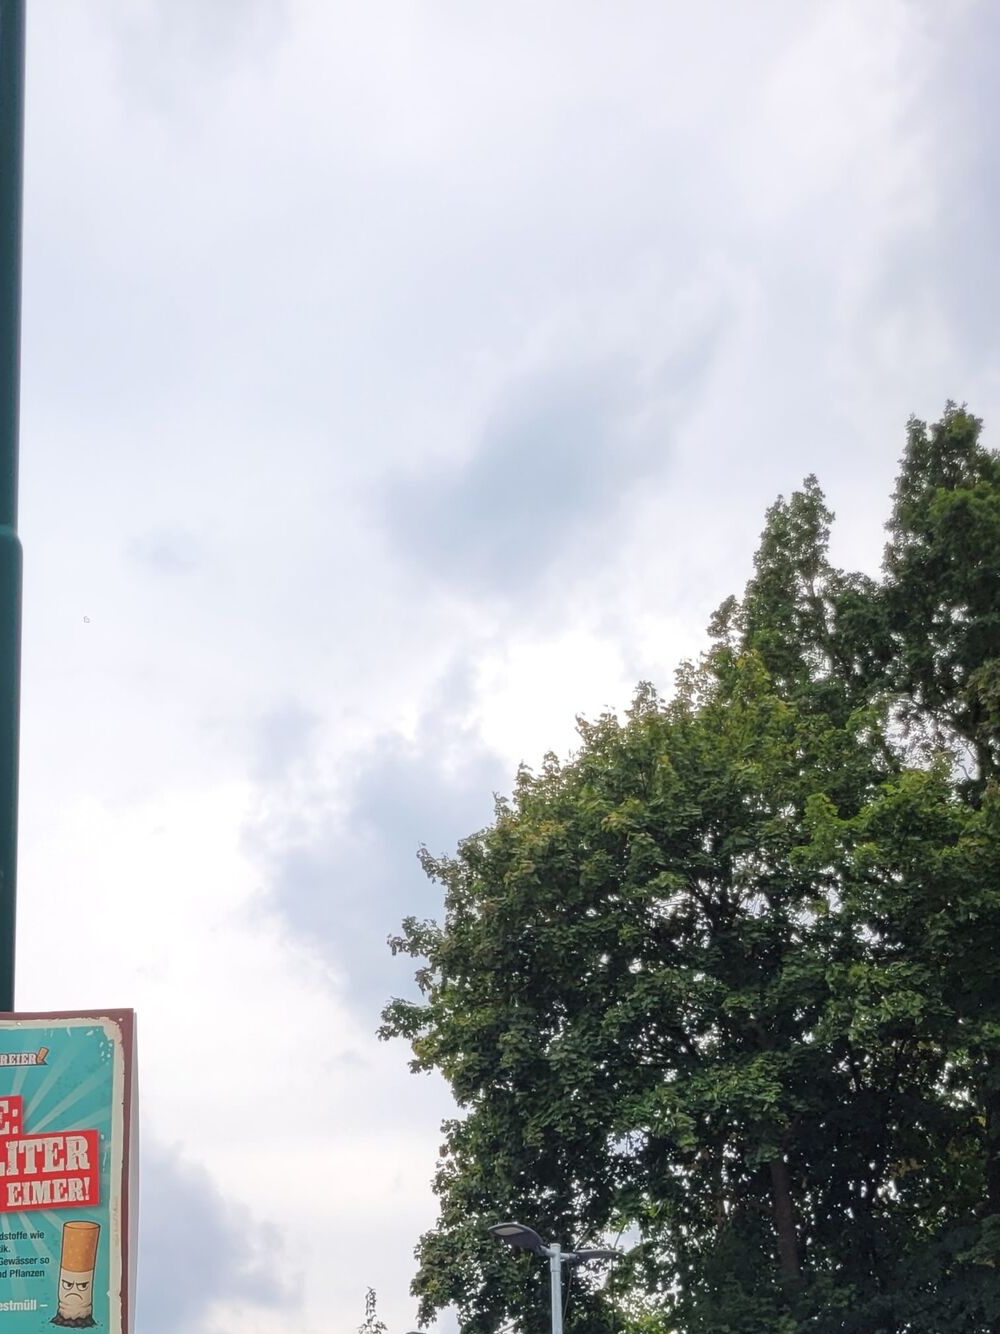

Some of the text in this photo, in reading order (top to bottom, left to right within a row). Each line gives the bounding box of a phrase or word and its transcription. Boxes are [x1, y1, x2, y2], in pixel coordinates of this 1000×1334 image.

[6, 1177, 90, 1206] EIMER!
[30, 1230, 44, 1239] wie
[10, 1269, 44, 1278] Pflanzen
